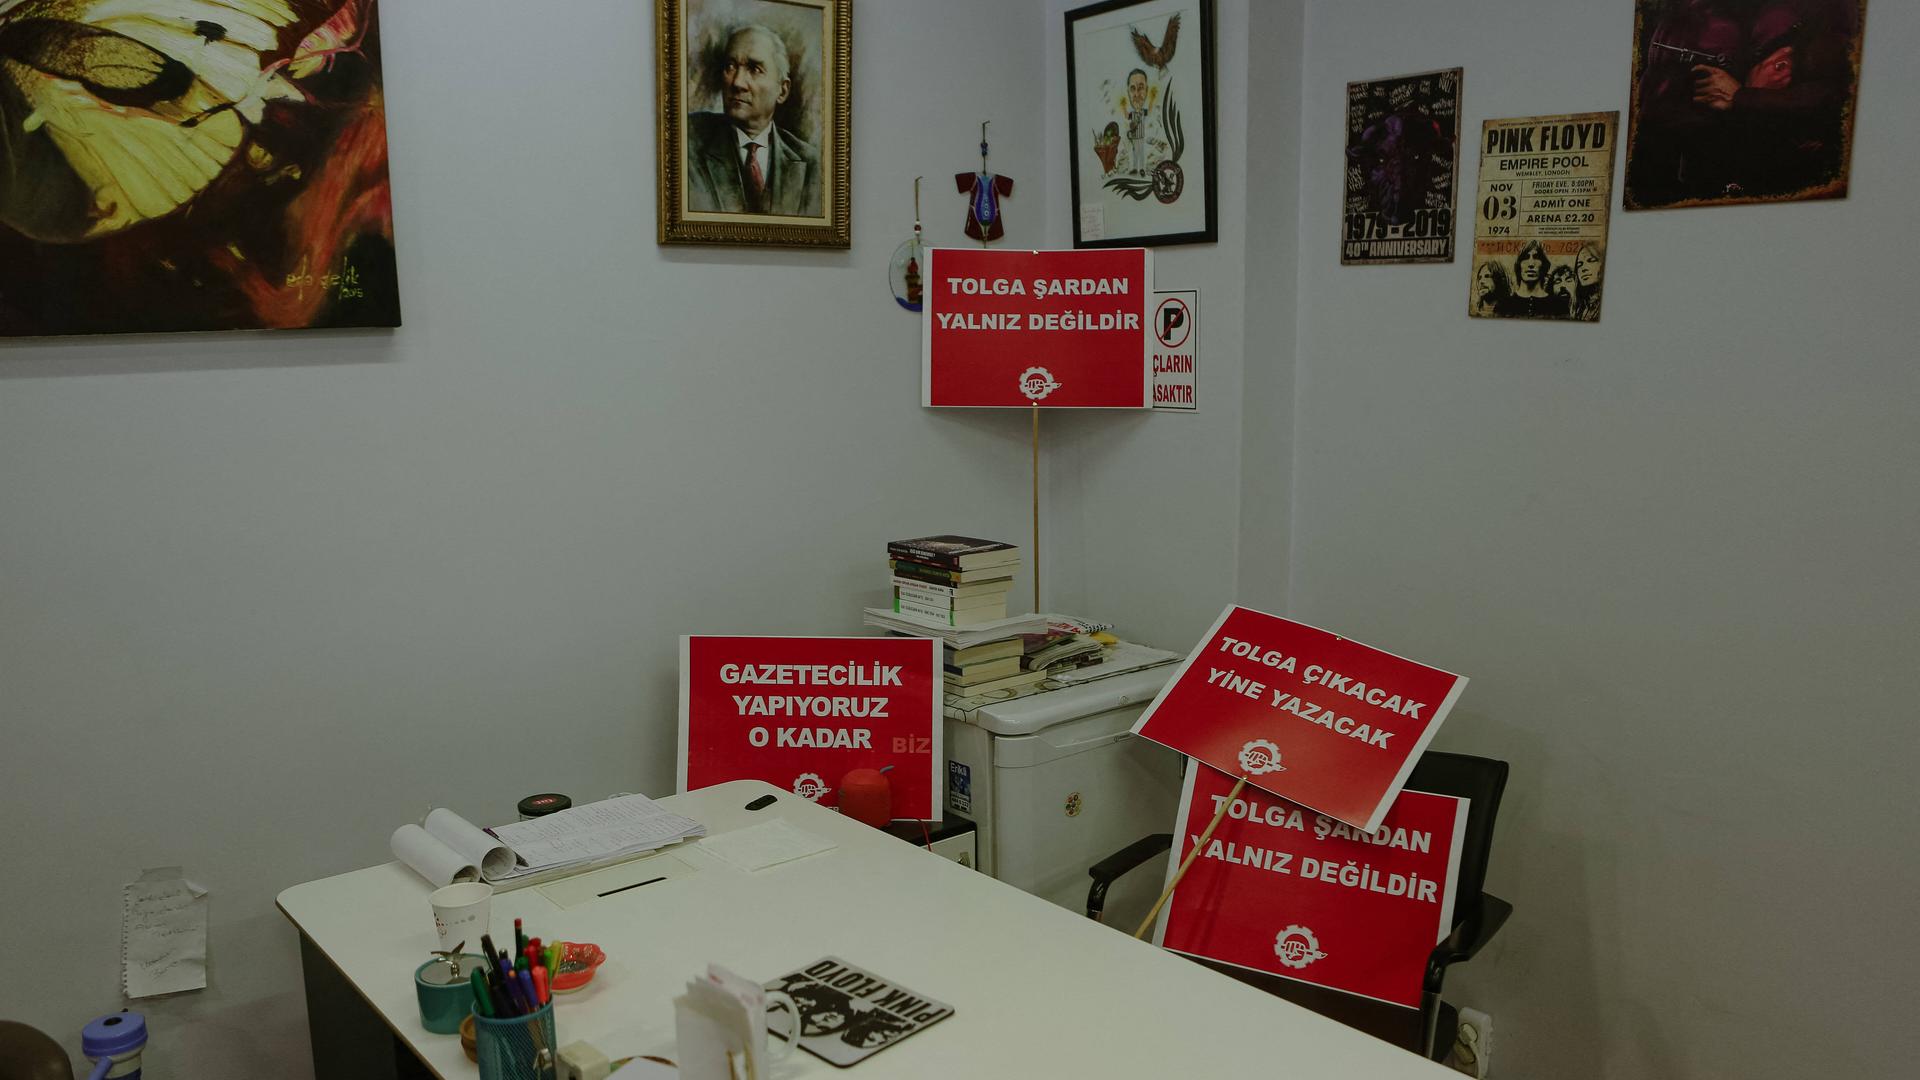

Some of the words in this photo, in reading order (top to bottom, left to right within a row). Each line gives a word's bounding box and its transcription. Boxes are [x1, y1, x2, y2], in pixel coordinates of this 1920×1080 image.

[1487, 127, 1536, 154] PINK
[1540, 123, 1606, 151] FLOYD
[1500, 158, 1549, 171] EMPIRE
[1552, 156, 1589, 168] POOL
[1490, 183, 1513, 192] NOV
[1532, 181, 1553, 189] FRIDAY
[1483, 195, 1517, 221] 03
[1533, 200, 1565, 209] ADMIT
[1568, 199, 1591, 208] ONE
[1527, 215, 1562, 223] ARENA
[1564, 213, 1595, 223] £2.20
[1488, 226, 1511, 235] 1974
[1369, 239, 1447, 257] ANNIVERSARY
[948, 277, 1026, 295] TOLGA
[1033, 277, 1129, 299] ŞARDAN
[937, 312, 1022, 330] YALNIZ
[1028, 310, 1140, 331] DEĞİLDİR
[719, 660, 903, 686] GAZETECİLİK
[1220, 636, 1297, 674] TOLGA
[1302, 664, 1427, 720] ÇIKACAK
[732, 696, 889, 718] YAPIYORUZ
[1207, 667, 1267, 700] YİNE
[1270, 689, 1396, 750] YAZACAK
[749, 727, 769, 748] O
[776, 728, 873, 749] KADAR
[892, 733, 930, 754] BİZ
[1211, 795, 1305, 832] TOLGA
[1190, 834, 1293, 875] YALNIZ
[1300, 857, 1438, 903] DEĞİLDİR
[804, 960, 887, 998] FLOYD
[871, 989, 946, 1023] PINK
